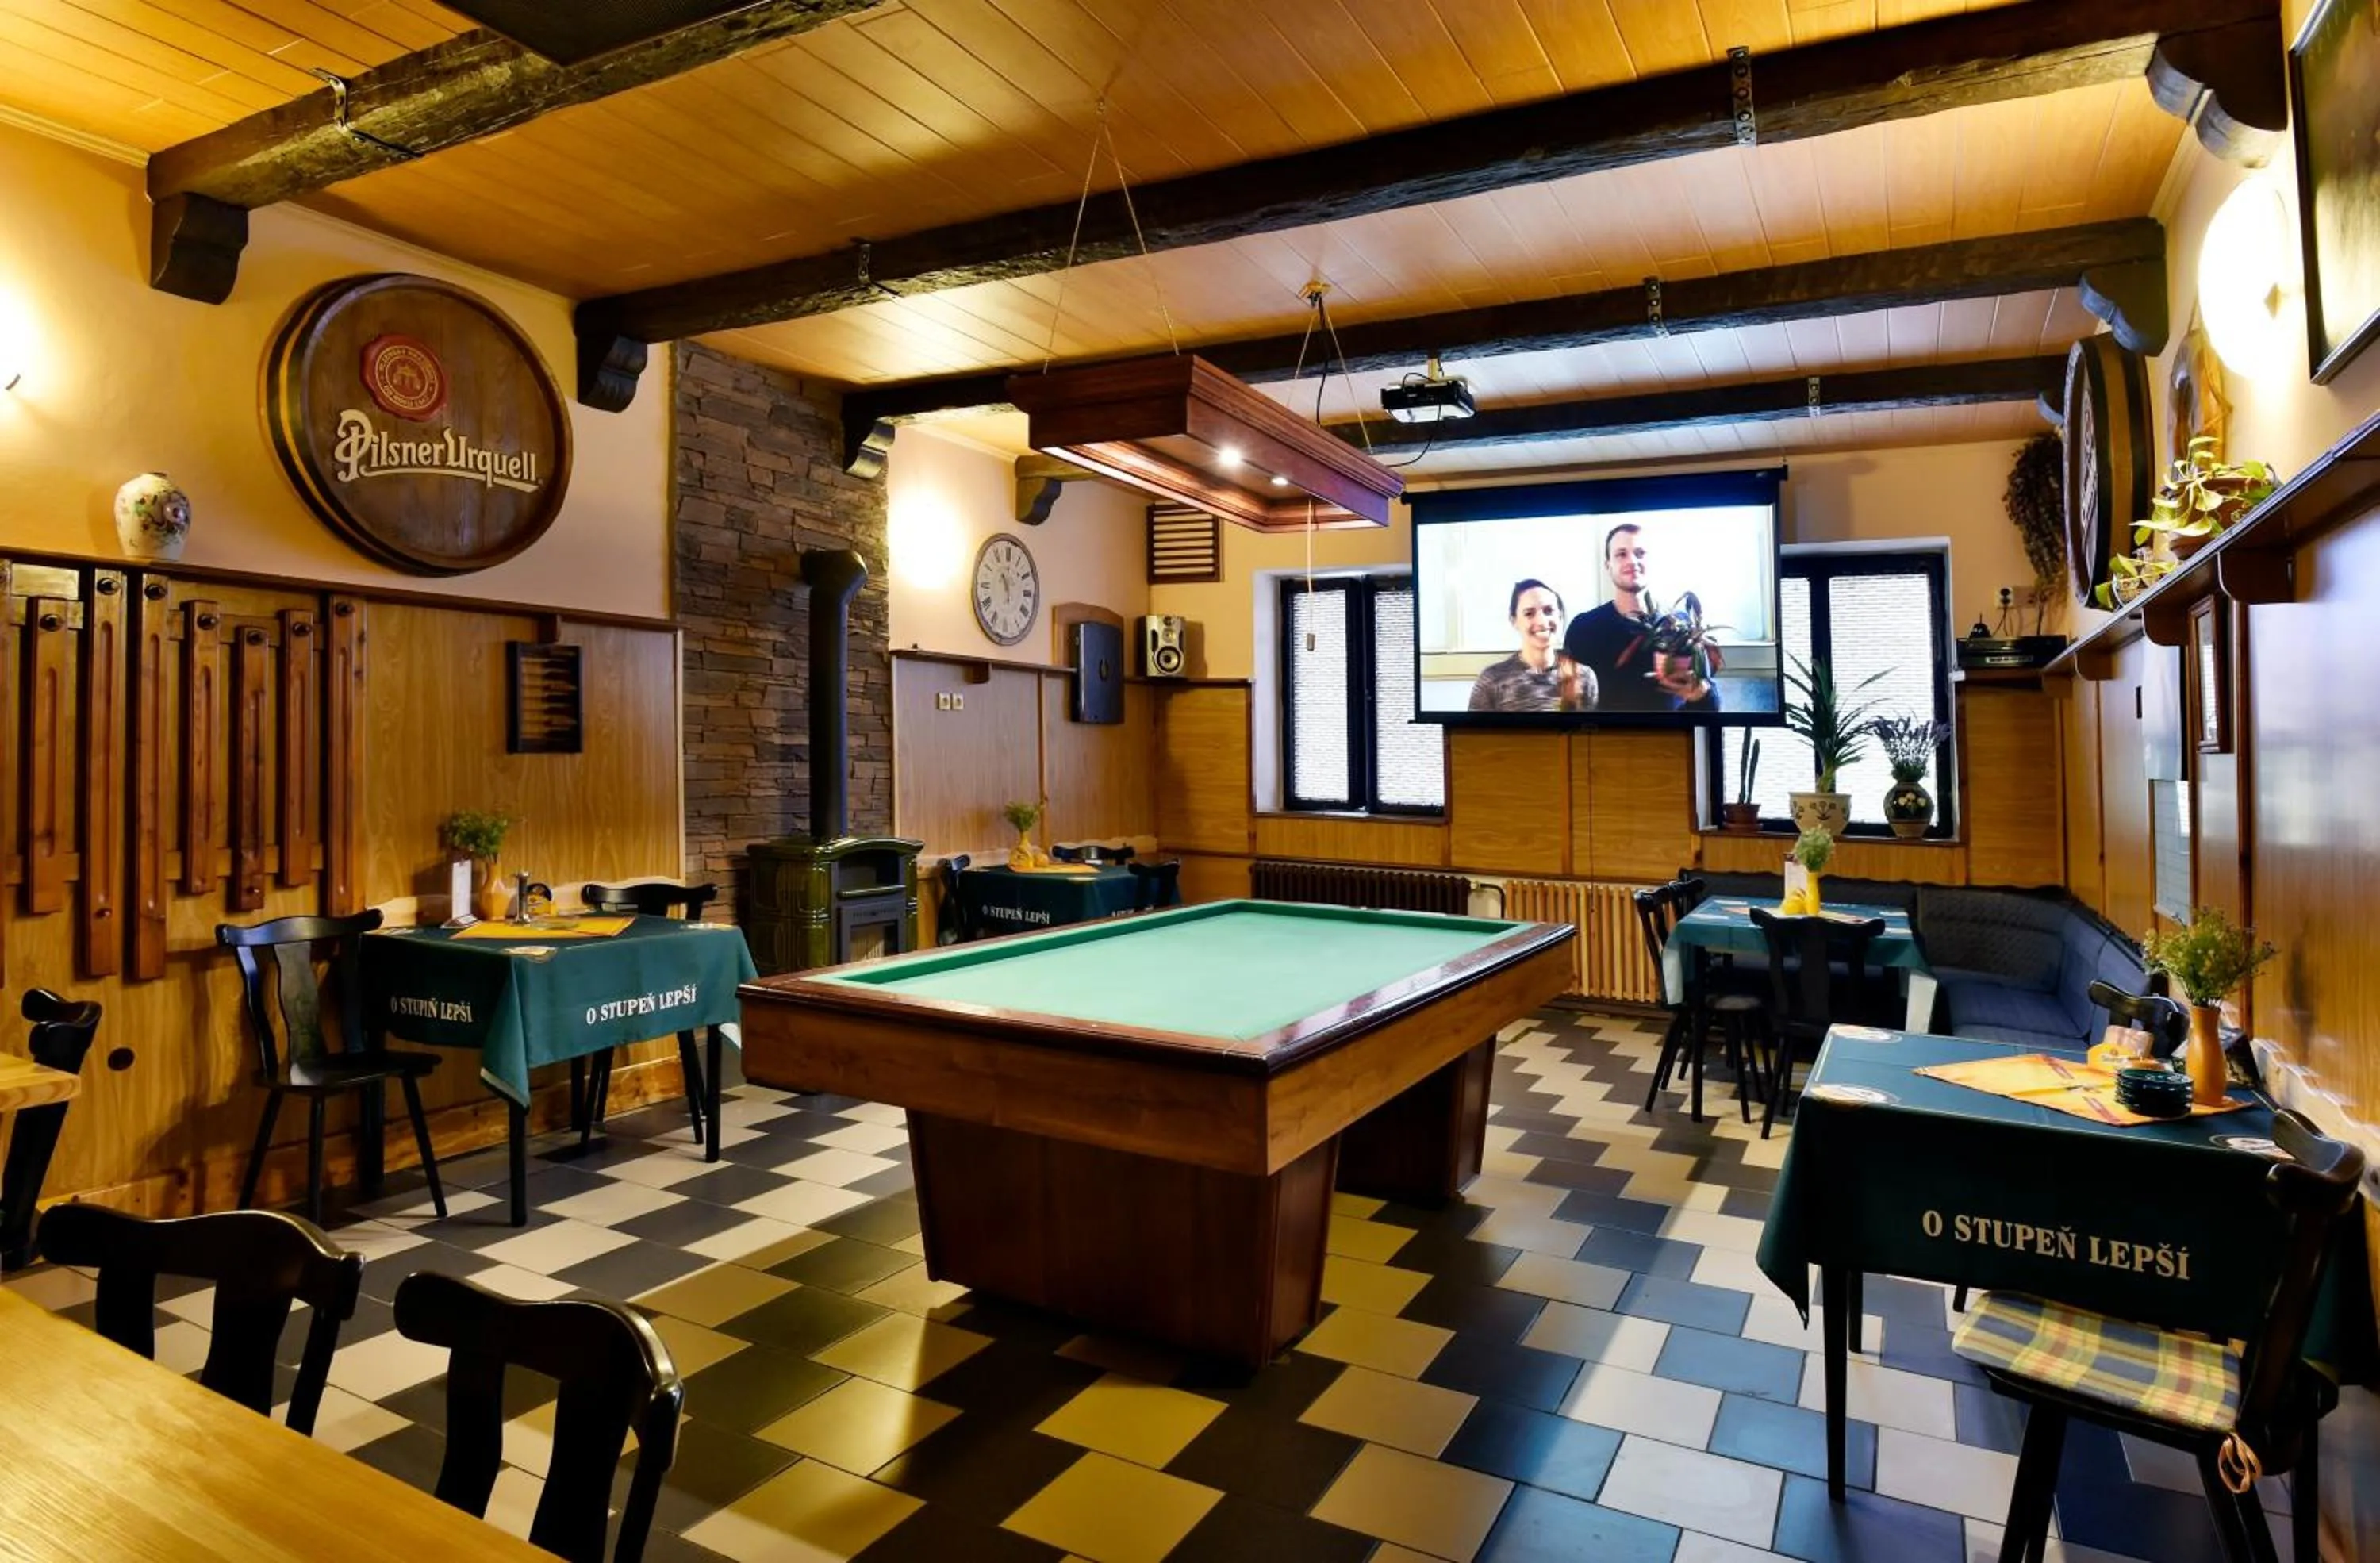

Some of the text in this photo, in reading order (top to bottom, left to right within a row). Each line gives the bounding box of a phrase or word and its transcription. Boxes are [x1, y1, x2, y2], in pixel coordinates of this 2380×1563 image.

[334, 409, 536, 488] Pilsner Urquell
[390, 997, 397, 1015] O
[586, 983, 697, 1025] O STUPEŇ LEPŠÍ
[1922, 1210, 2191, 1280] O STUPEŇ LEPŠÍ
